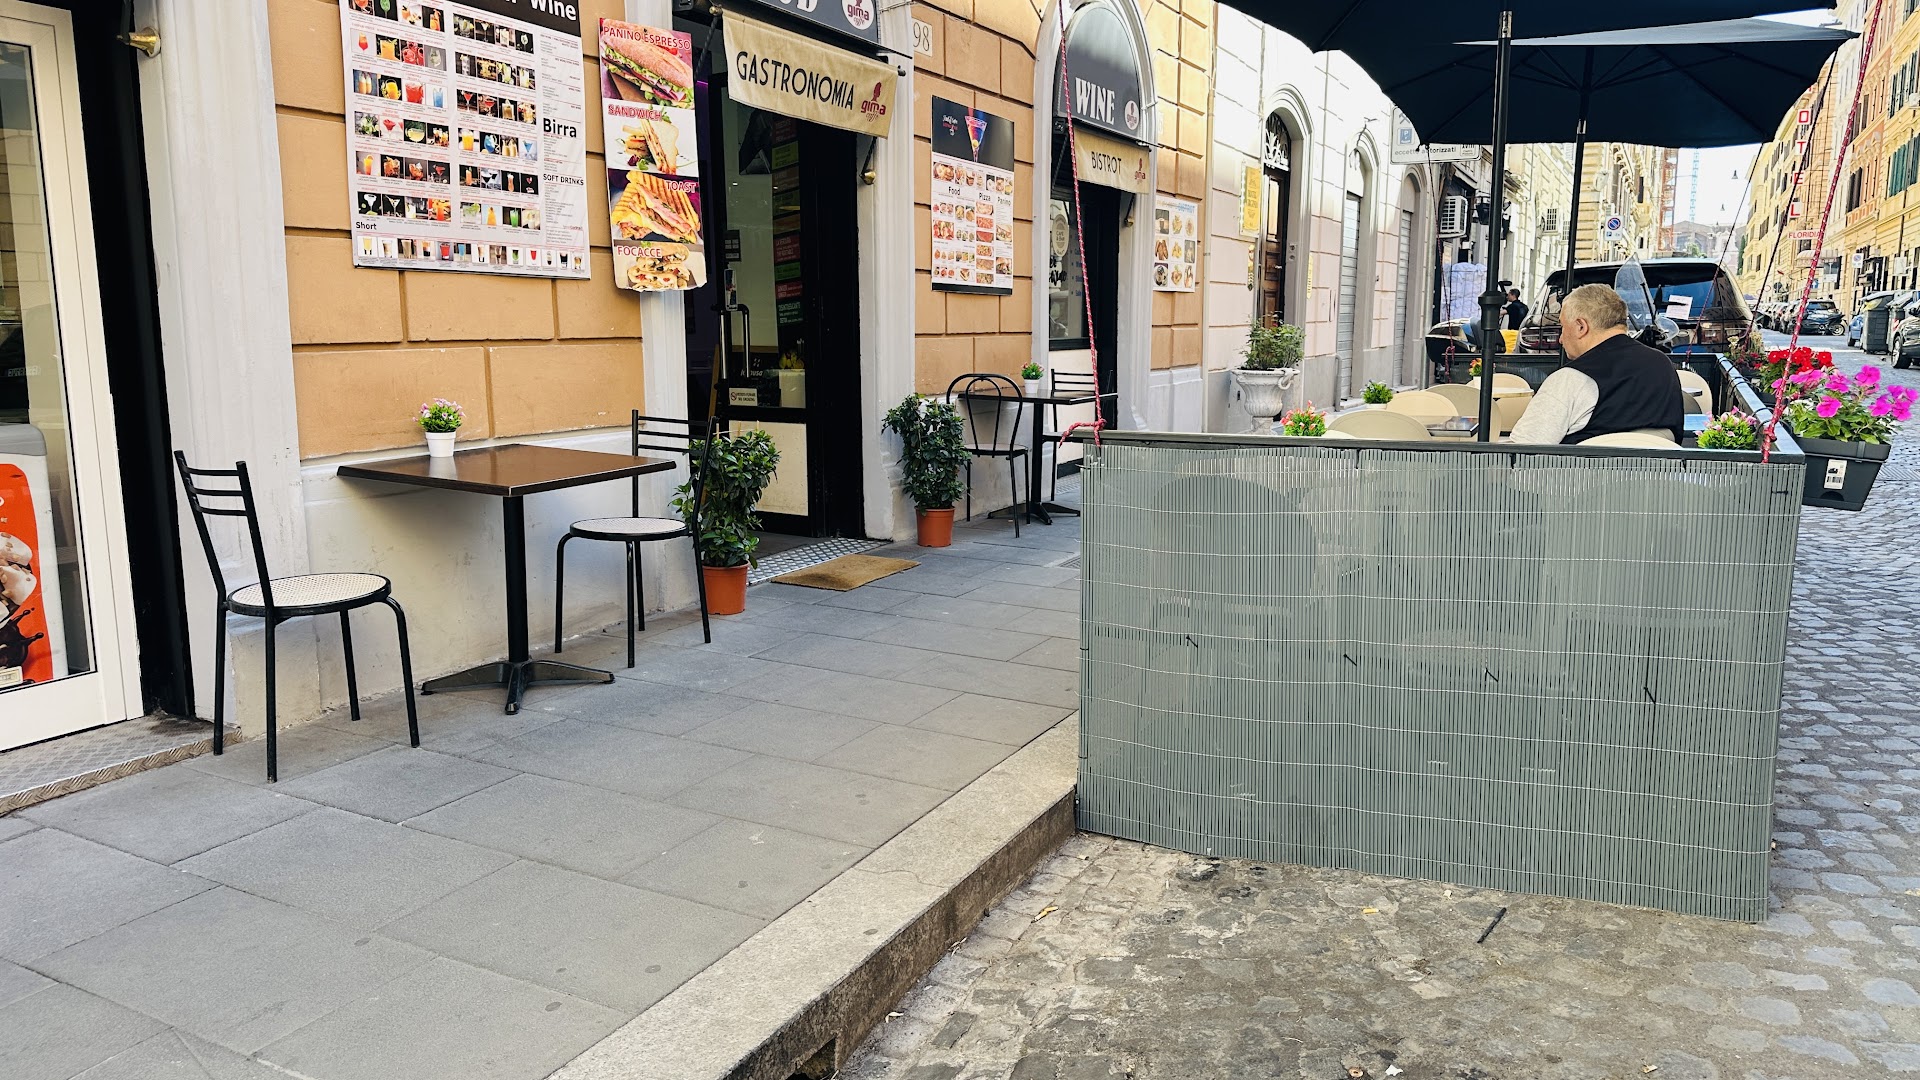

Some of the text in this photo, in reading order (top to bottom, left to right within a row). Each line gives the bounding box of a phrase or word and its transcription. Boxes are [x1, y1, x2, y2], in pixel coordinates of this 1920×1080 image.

[847, 4, 870, 21] gima
[603, 26, 691, 50] PANINO ESPRESSO
[913, 21, 930, 51] 98
[736, 51, 854, 110] GASTRONOMIA
[861, 100, 886, 115] gima
[1075, 77, 1115, 125] WINE
[608, 104, 662, 121] SANDWICH
[543, 117, 577, 138] Birra
[1091, 151, 1122, 175] BISTROT
[543, 173, 584, 186] SOFT DRINKS
[666, 180, 696, 193] TOAST
[948, 186, 961, 196] Food
[979, 192, 991, 202] Pizza
[355, 221, 377, 230] Short
[617, 246, 662, 258] FOCACCE
